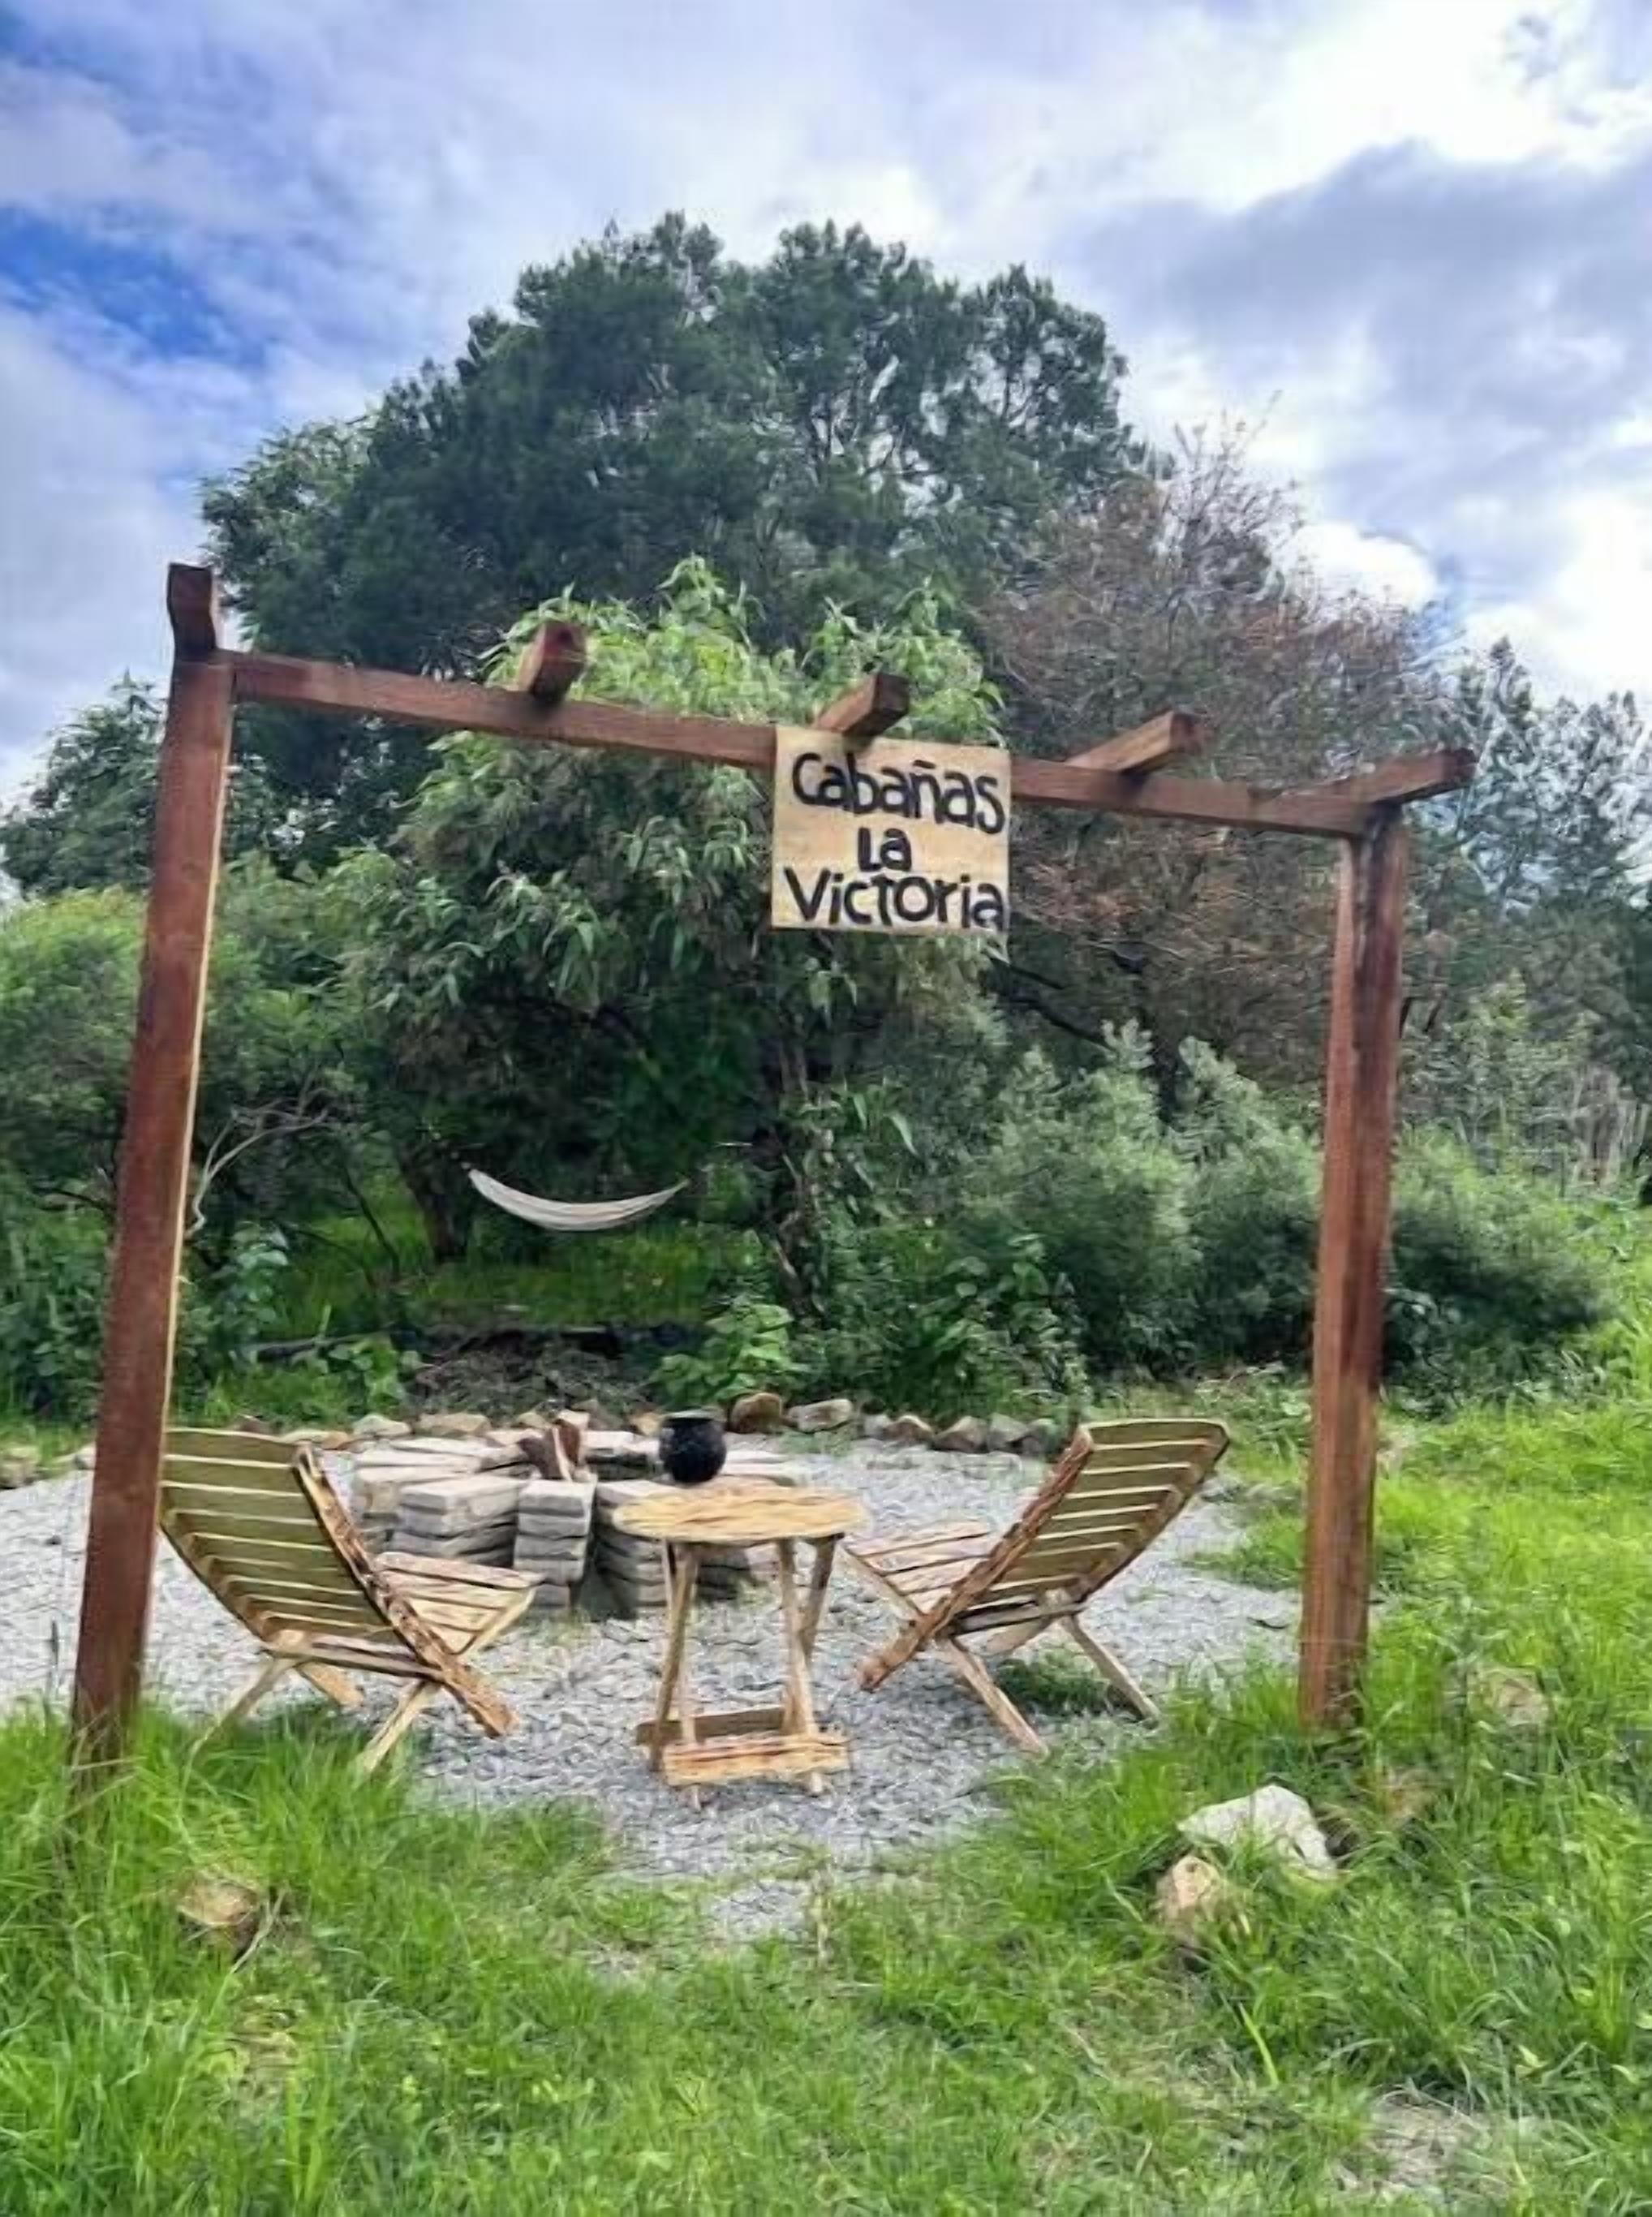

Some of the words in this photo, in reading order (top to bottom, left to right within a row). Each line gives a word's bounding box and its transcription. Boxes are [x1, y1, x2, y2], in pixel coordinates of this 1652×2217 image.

[792, 751, 1005, 834] Cabañas
[858, 827, 912, 872] La
[783, 866, 1005, 931] Victoria
